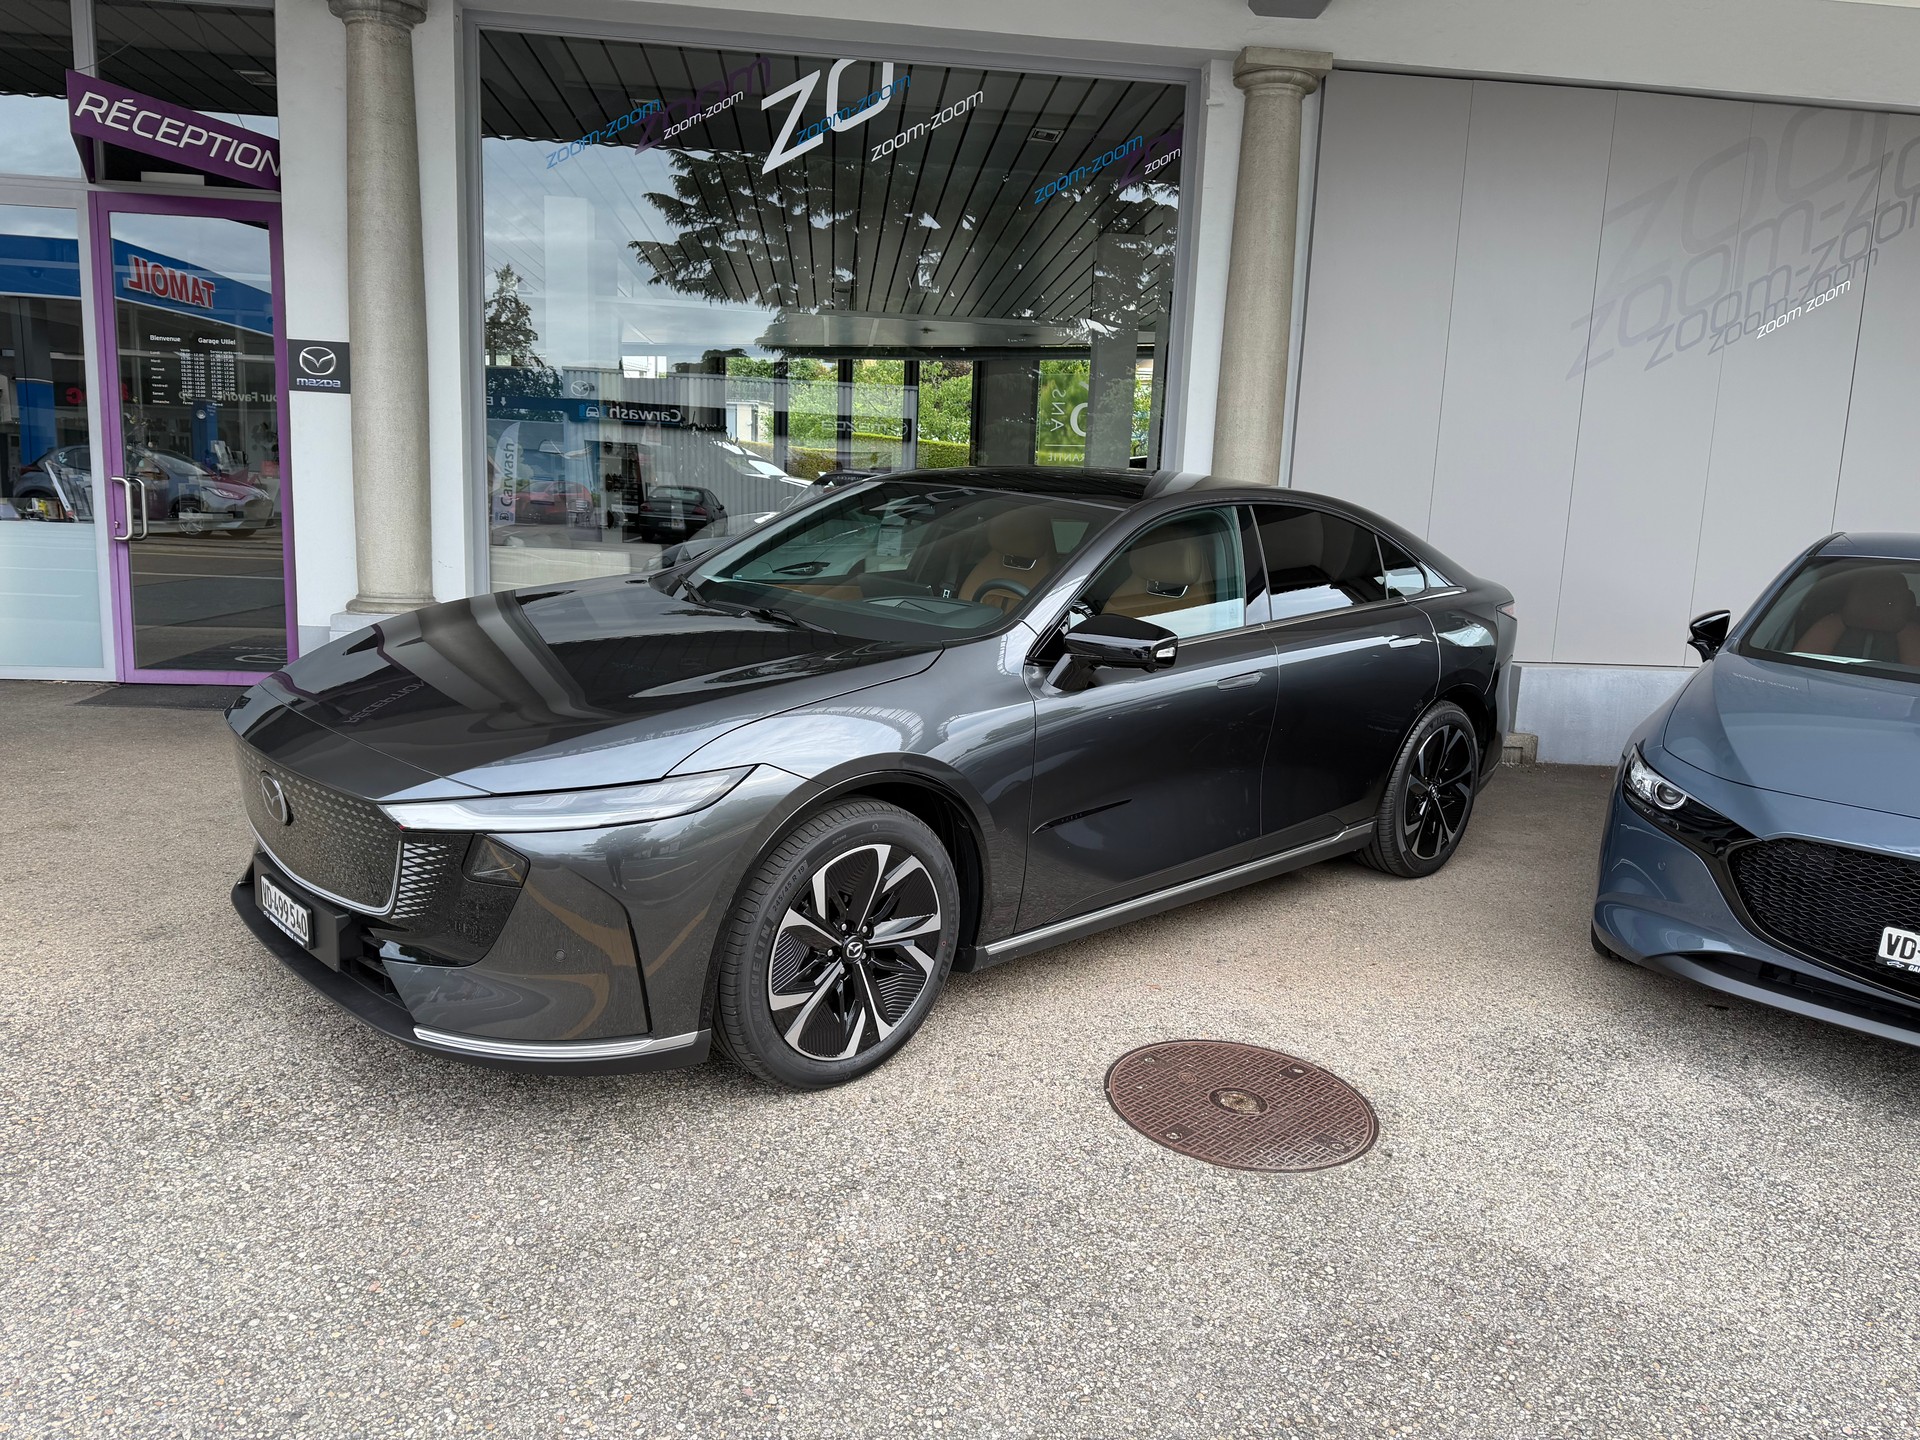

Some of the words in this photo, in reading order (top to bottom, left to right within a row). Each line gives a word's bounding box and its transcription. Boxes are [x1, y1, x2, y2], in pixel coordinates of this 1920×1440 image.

[74, 90, 281, 178] RÉCEPTION
[546, 99, 661, 170] zoom-zoom
[663, 90, 744, 141] zoom-zoom
[796, 74, 911, 147] zoom-zoom
[871, 89, 984, 162] zoom-zoom
[1034, 135, 1143, 205] zoom-zoom
[1144, 148, 1181, 175] zoom
[149, 334, 181, 342] Bienvenue
[1756, 303, 1802, 340] zoom
[1805, 279, 1851, 311] zoom
[296, 378, 341, 387] mazda
[501, 443, 515, 507] Carwash
[773, 882, 792, 912] 245/45
[791, 874, 798, 882] R
[797, 865, 805, 875] 19
